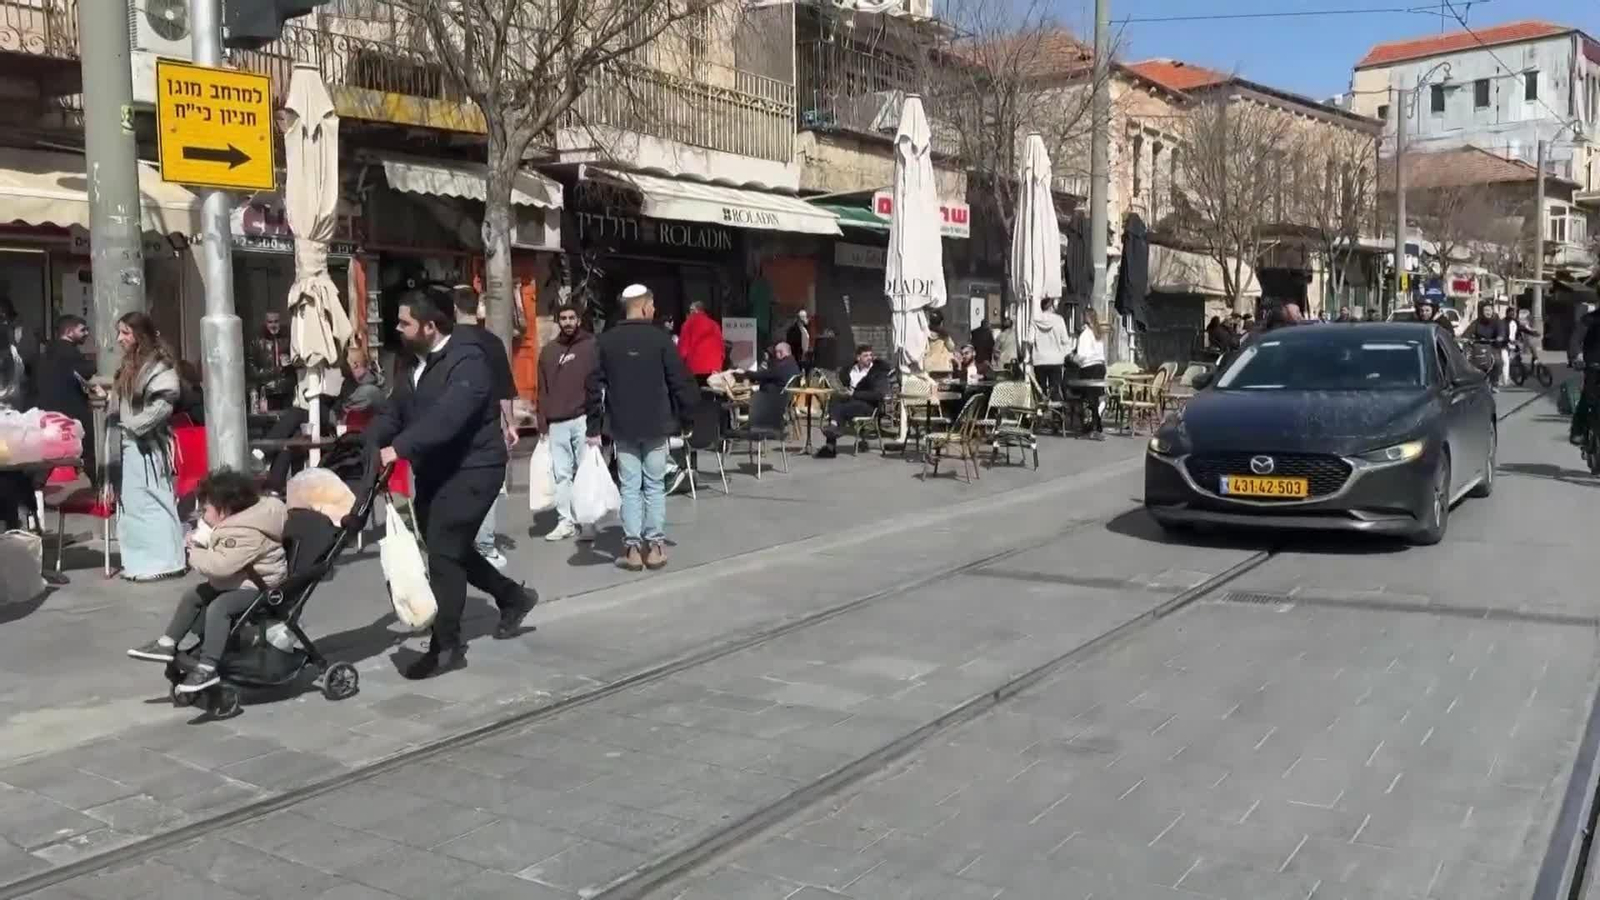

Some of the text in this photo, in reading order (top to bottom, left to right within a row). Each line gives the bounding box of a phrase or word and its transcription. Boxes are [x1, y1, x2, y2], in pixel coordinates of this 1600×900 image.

[167, 78, 262, 104] למרחב מוגן
[220, 108, 258, 127] חניון
[732, 208, 780, 226] ROLADIN
[659, 222, 733, 250] ROLADIN
